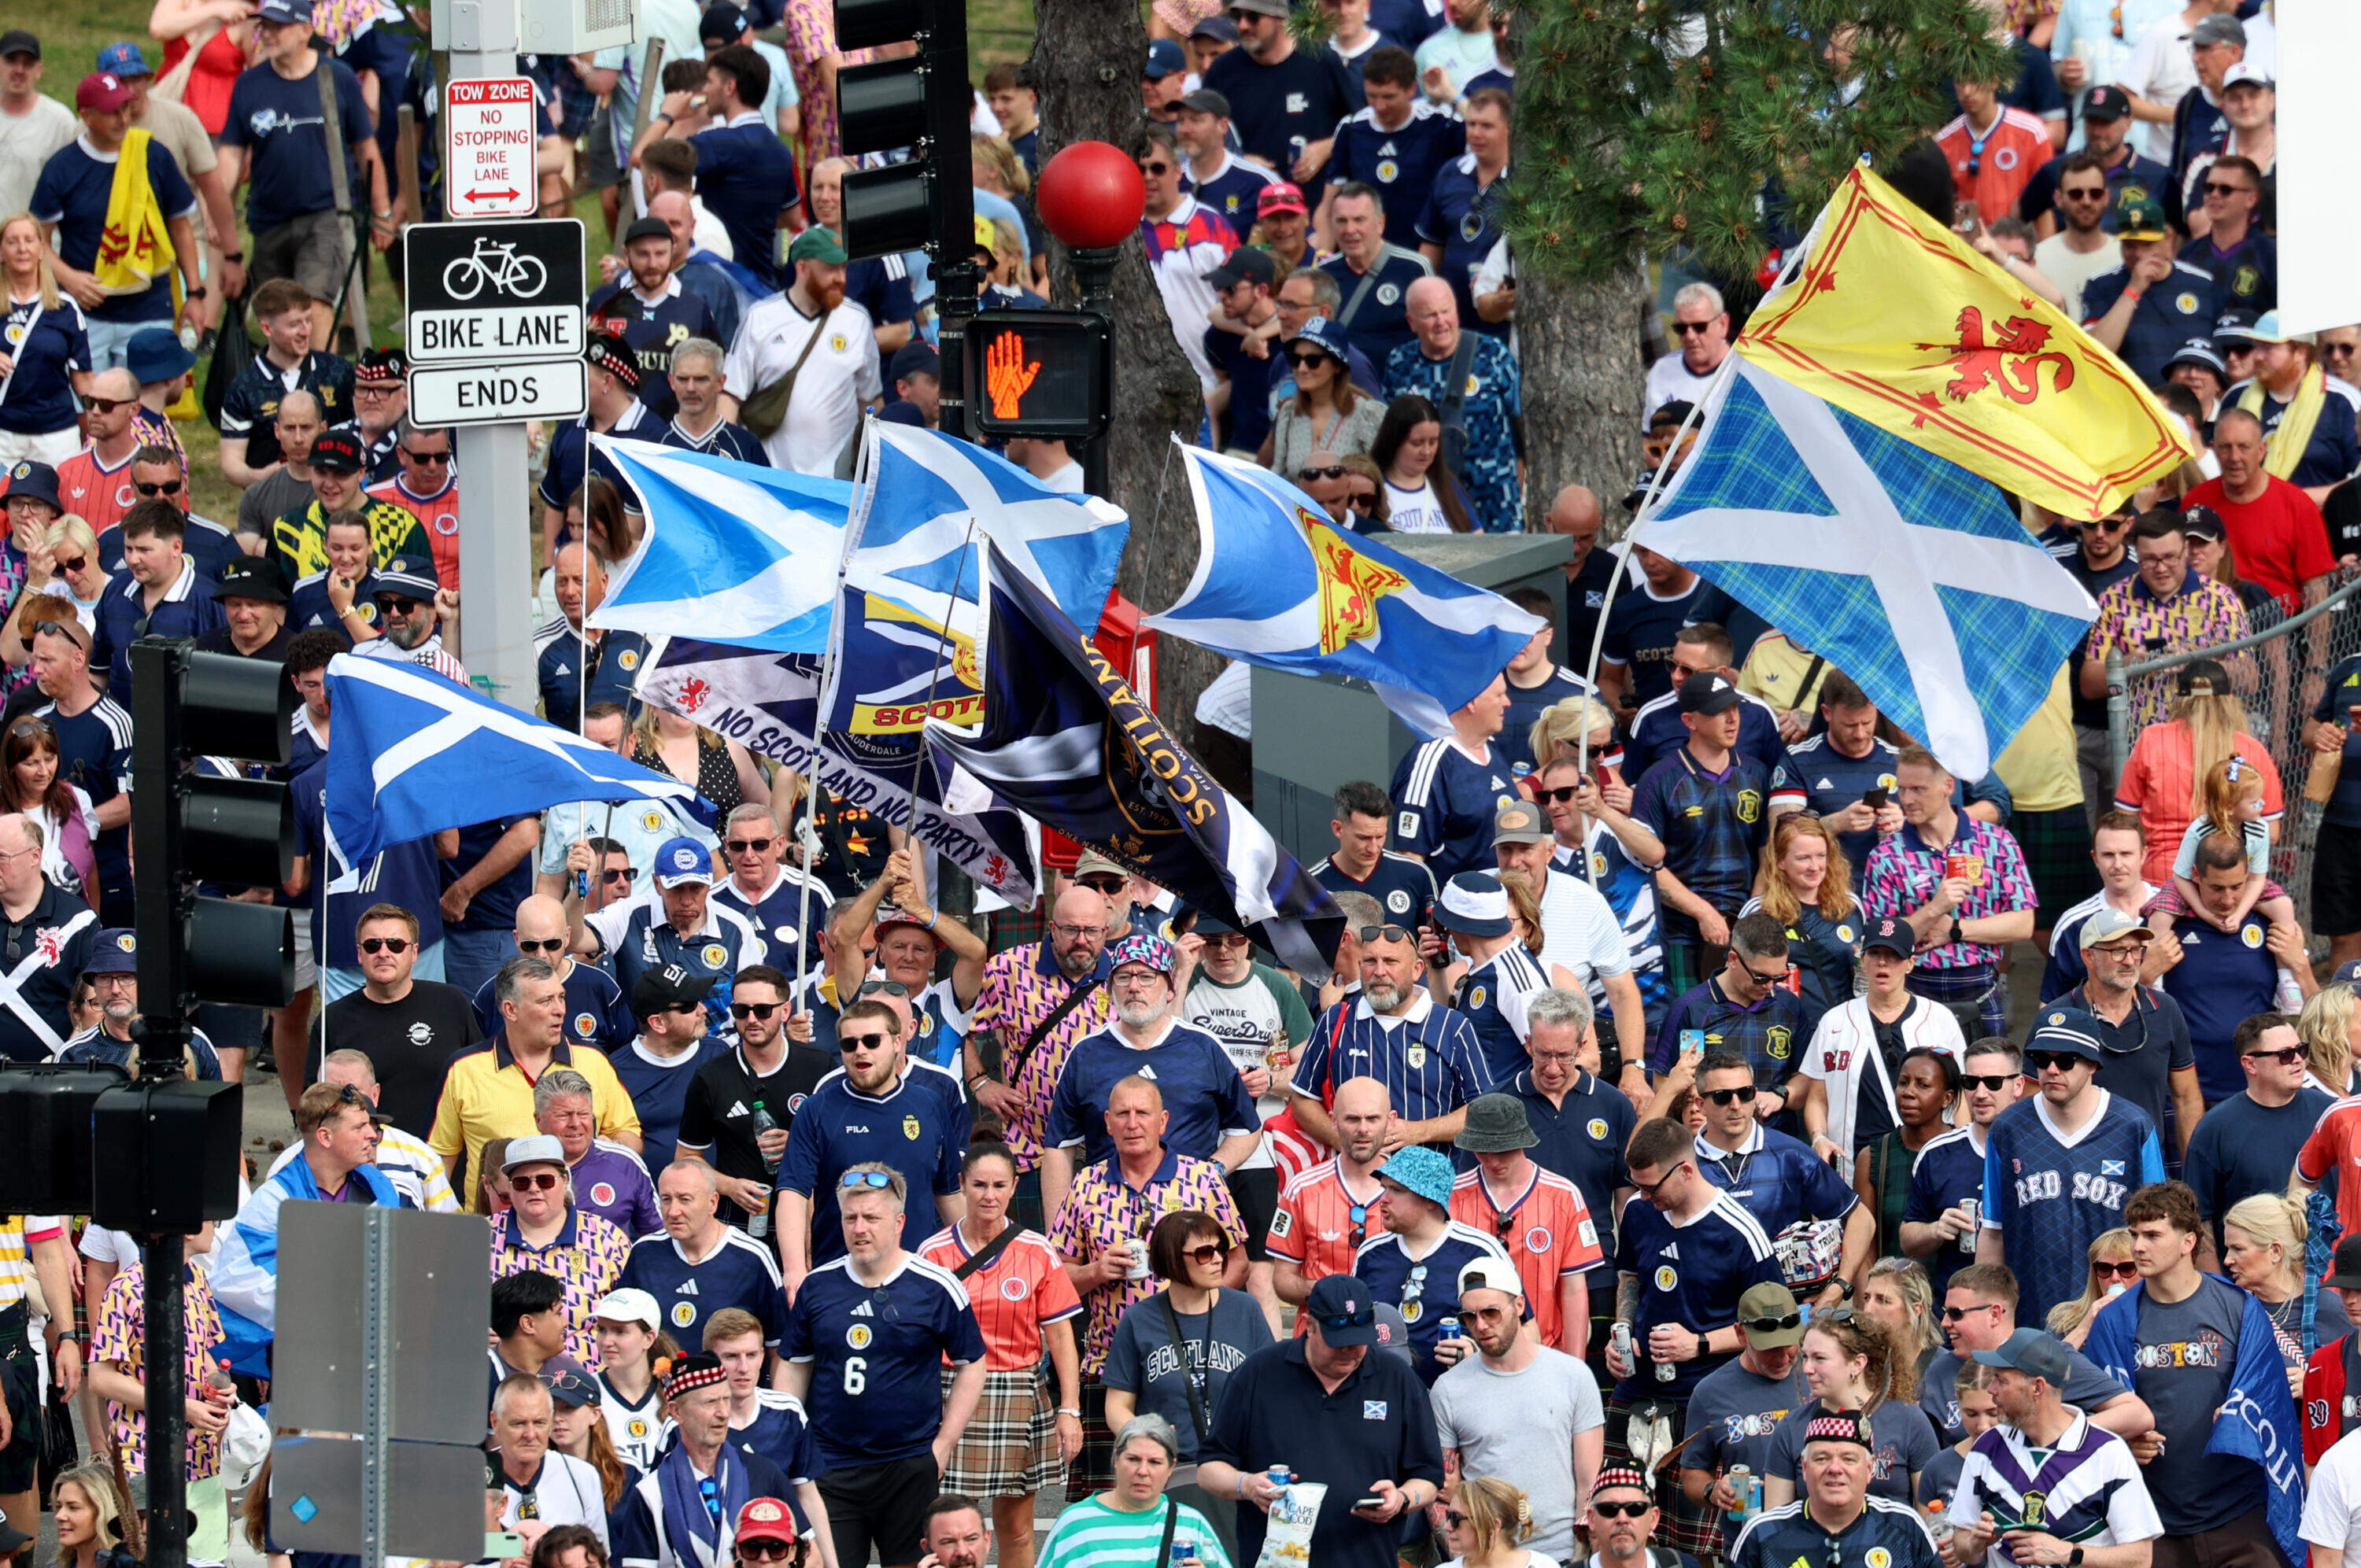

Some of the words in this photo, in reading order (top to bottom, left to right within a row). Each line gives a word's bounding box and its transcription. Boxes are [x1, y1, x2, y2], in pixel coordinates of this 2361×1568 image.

[452, 84, 484, 101] TOW
[489, 83, 530, 100] ZONE
[481, 109, 502, 124] NO
[454, 129, 528, 146] STOPPING
[477, 150, 507, 164] BIKE
[475, 168, 509, 181] LANE
[423, 318, 483, 349] BIKE
[499, 315, 569, 346] LANE
[458, 376, 538, 408] ENDS
[1392, 507, 1450, 529] SCOTAN
[1635, 647, 1673, 662] SCOT
[711, 707, 754, 738] NO
[749, 726, 878, 807] SCOTLAND
[874, 796, 911, 827] NO
[910, 813, 985, 866] PARTY
[1189, 766, 1212, 791] FIFA
[1058, 828, 1077, 843] ONE
[1082, 840, 1121, 864] NATION
[1126, 864, 1147, 878] ONE
[1149, 876, 1184, 898] DREAM
[1879, 920, 1895, 936] B
[1210, 1009, 1247, 1018] VINTAGE
[1823, 1050, 1850, 1072] RD
[845, 1125, 870, 1134] FILA
[2014, 1170, 2062, 1208] RED
[2071, 1171, 2127, 1210] SOX
[1375, 1323, 1391, 1343] B
[844, 1356, 867, 1395] 6
[1288, 1503, 1314, 1517] CAPE
[1290, 1514, 1313, 1526] COD
